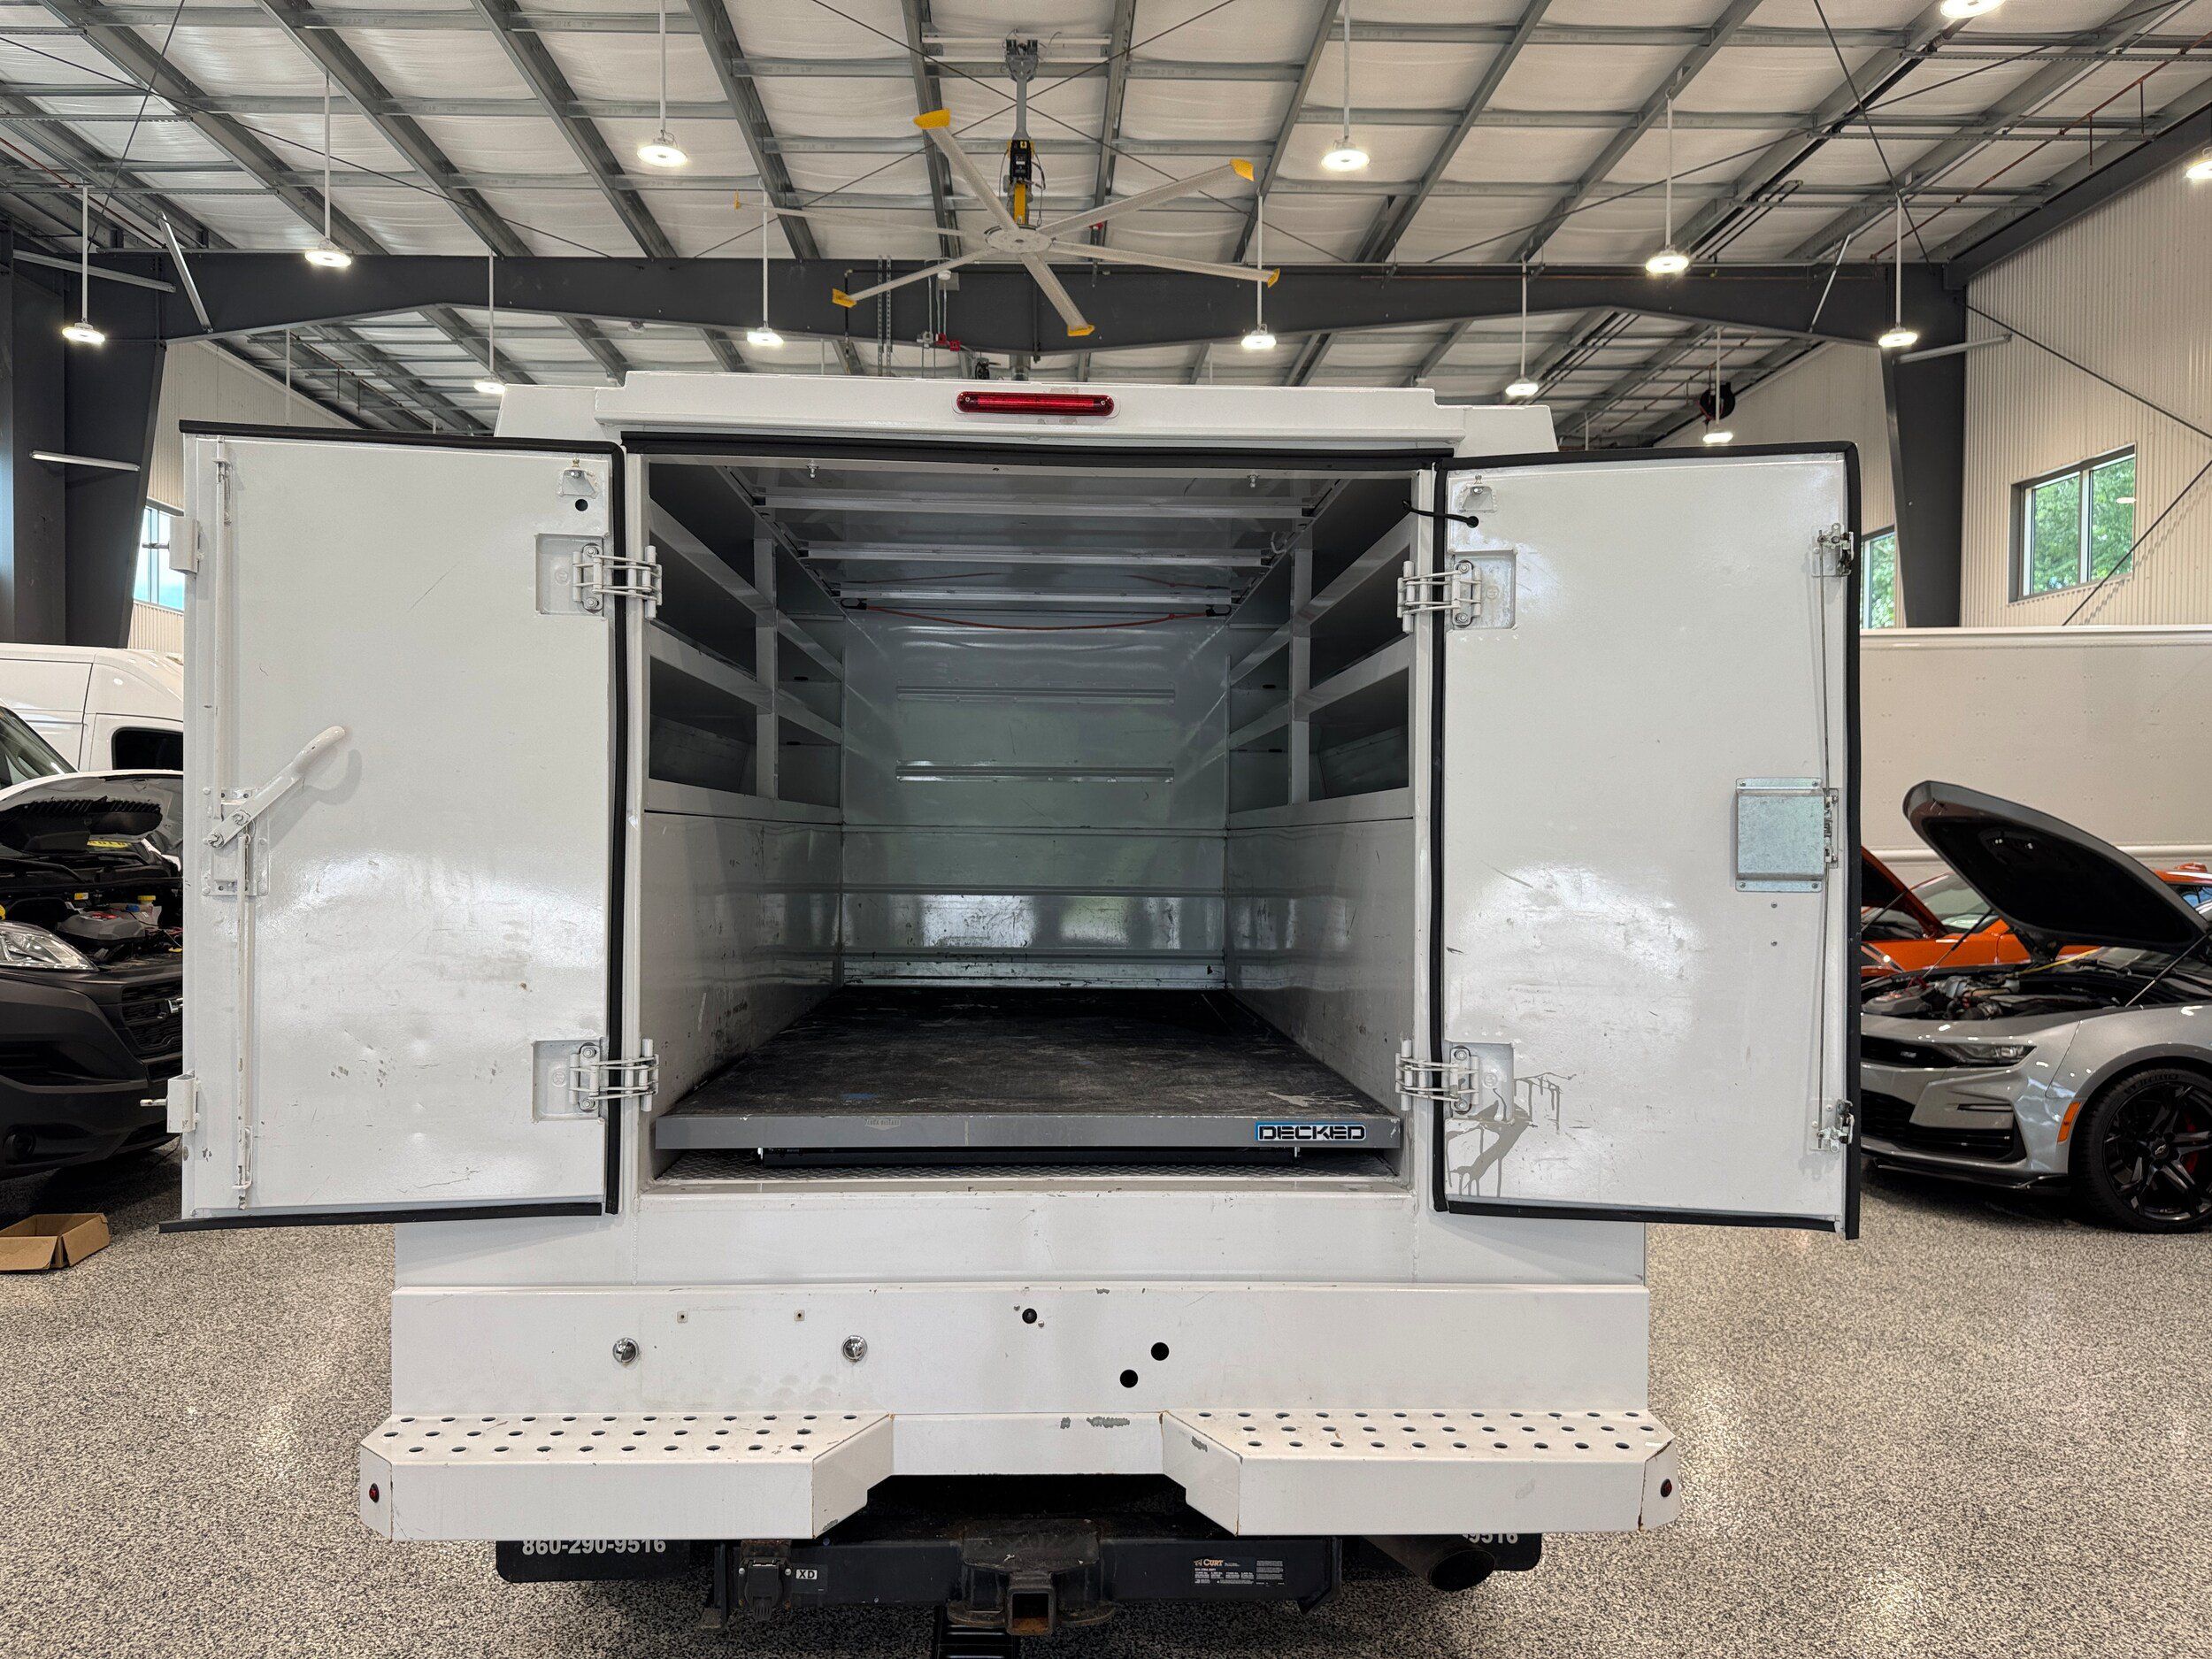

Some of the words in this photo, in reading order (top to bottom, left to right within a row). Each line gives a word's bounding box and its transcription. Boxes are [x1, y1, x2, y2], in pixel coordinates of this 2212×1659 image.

[1258, 1125, 1365, 1140] DECKED
[522, 1540, 666, 1555] 860-290-9516
[798, 1570, 815, 1579] XD
